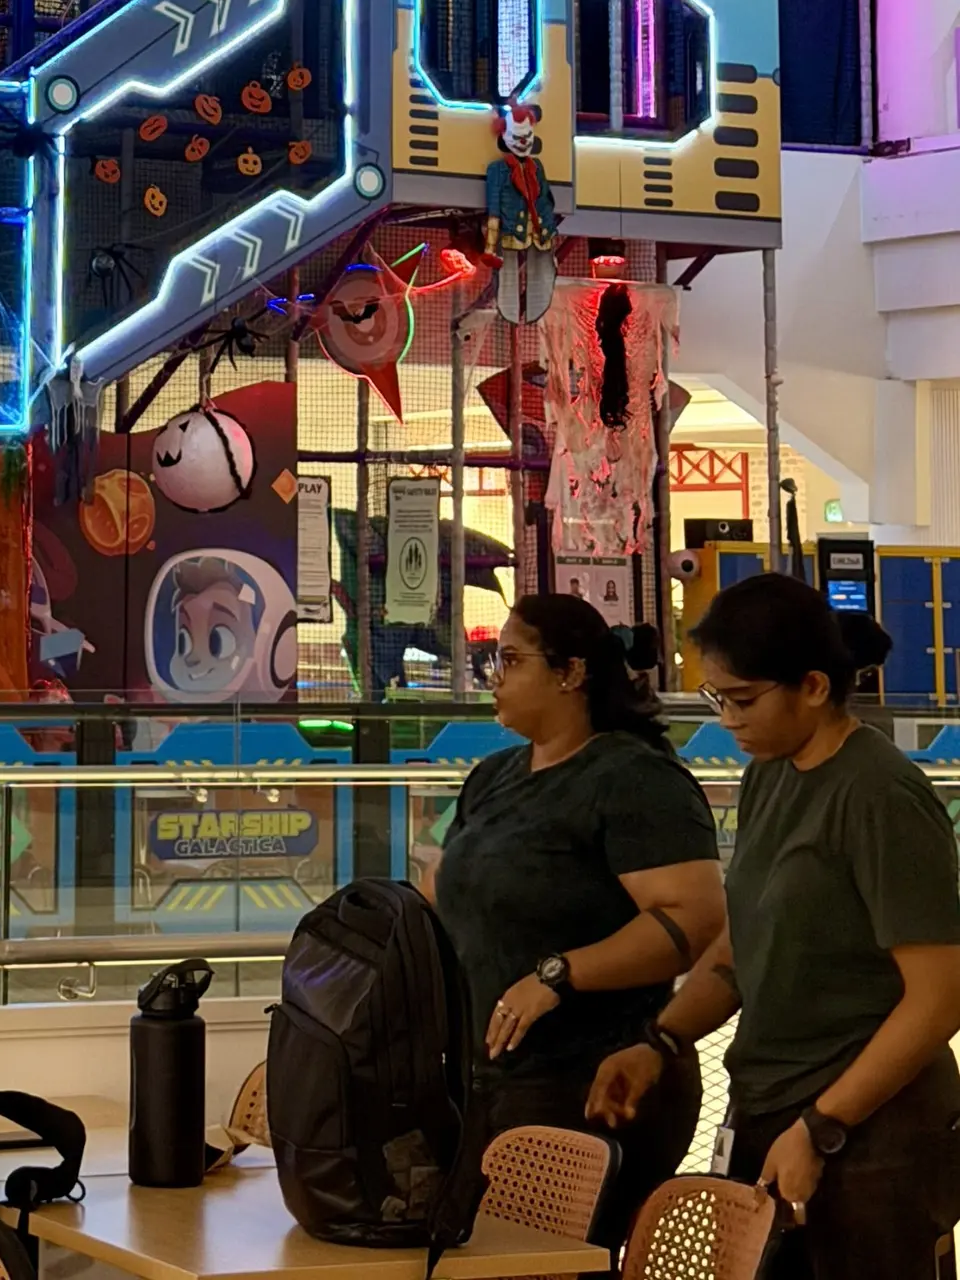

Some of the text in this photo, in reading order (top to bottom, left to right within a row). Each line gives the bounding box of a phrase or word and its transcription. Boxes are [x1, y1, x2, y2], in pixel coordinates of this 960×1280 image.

[297, 482, 322, 494] PLAY
[156, 811, 312, 841] STARSHIP
[174, 834, 287, 857] GALACTICA
